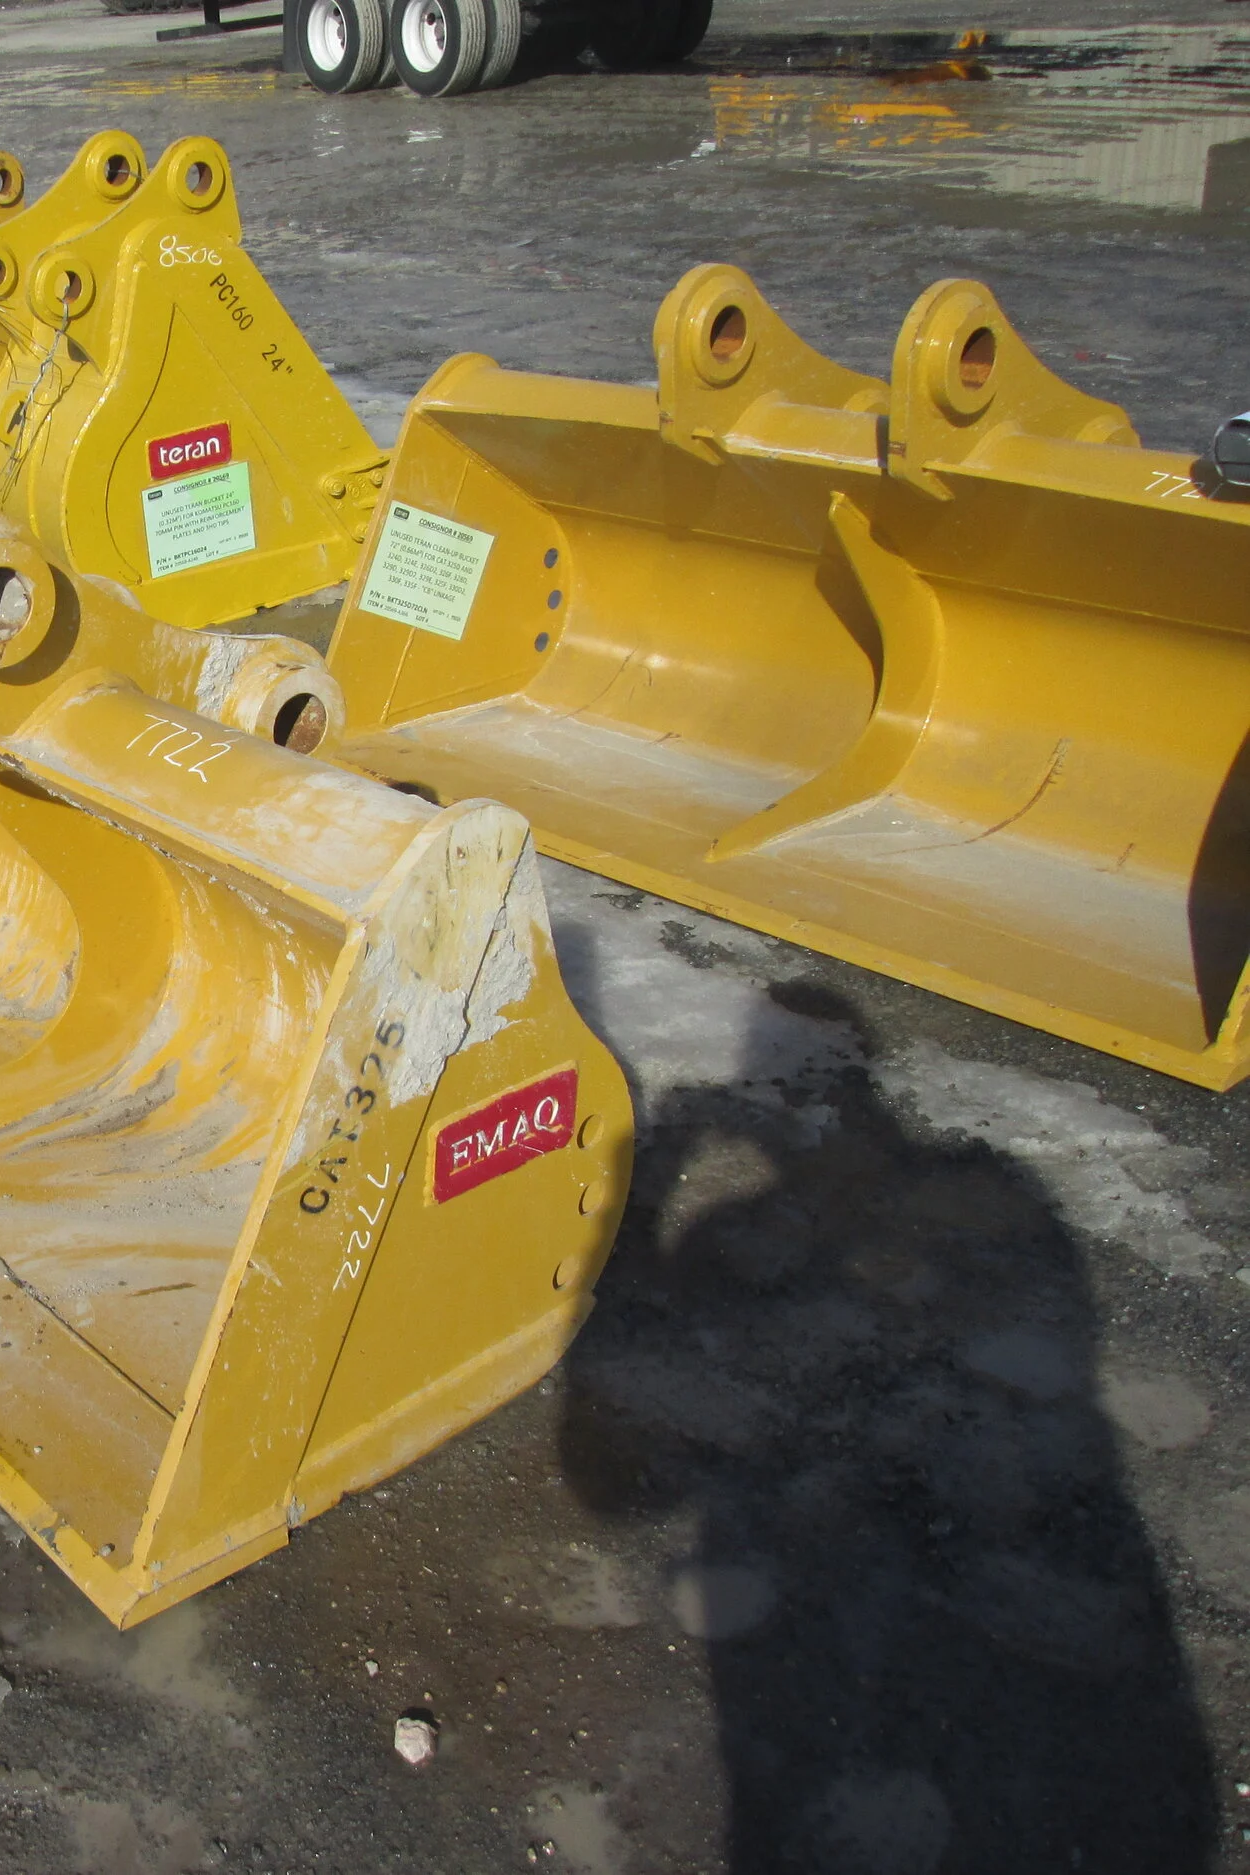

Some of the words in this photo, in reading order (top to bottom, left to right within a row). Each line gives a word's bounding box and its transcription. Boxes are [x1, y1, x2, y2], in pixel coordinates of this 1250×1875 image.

[209, 272, 254, 331] PC160
[261, 343, 293, 374] 24"
[159, 437, 221, 466] teran
[419, 518, 453, 535] CONSIGNOR
[126, 714, 231, 782] 7722
[450, 1095, 564, 1176] EMAQ
